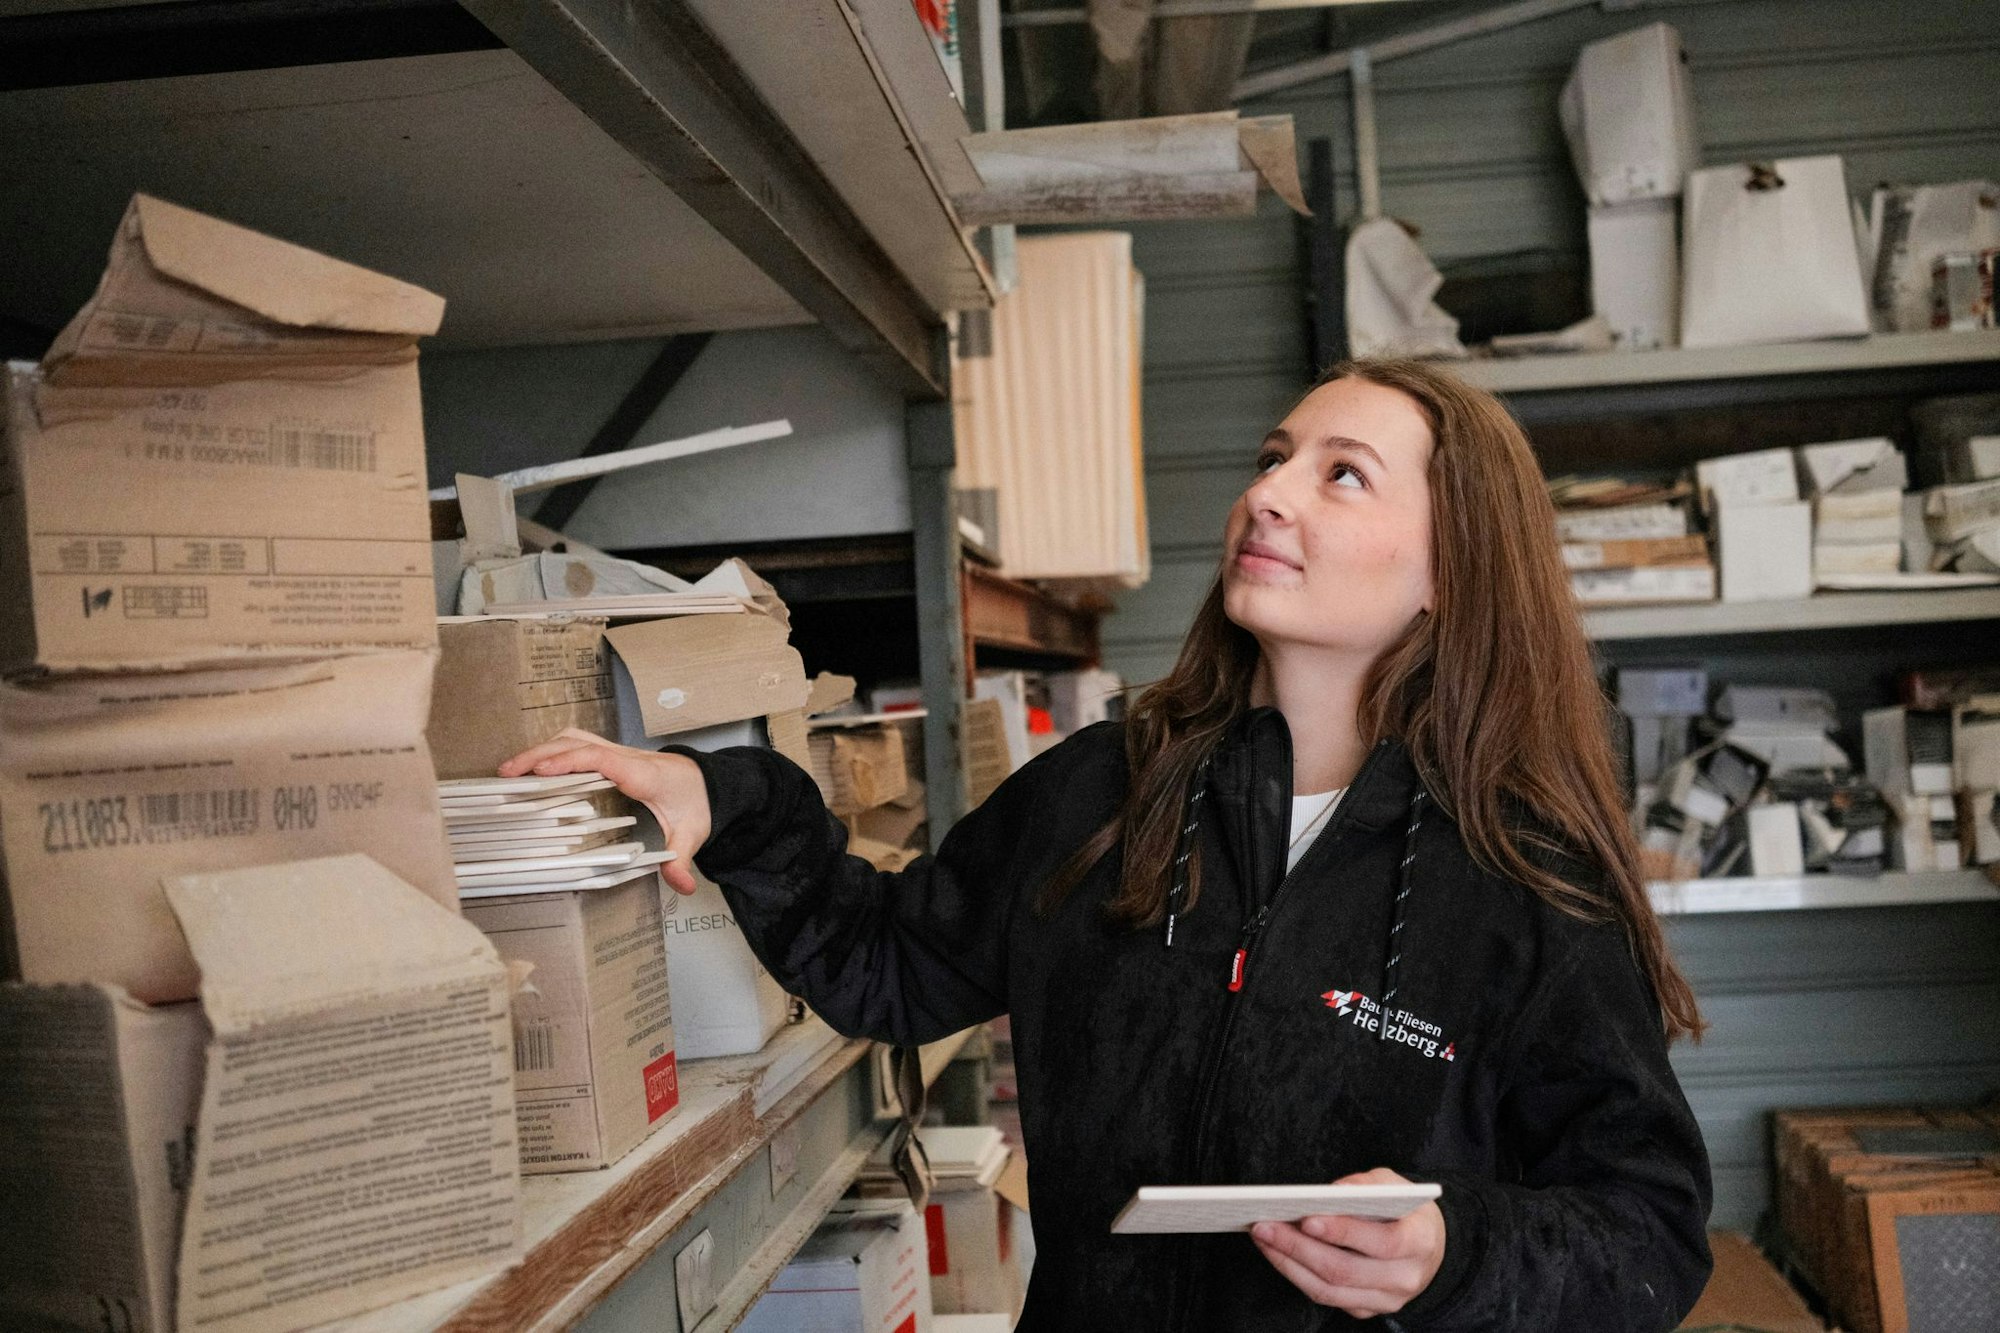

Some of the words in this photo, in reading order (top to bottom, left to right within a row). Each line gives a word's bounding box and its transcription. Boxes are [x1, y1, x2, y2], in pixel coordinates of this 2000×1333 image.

[664, 914, 736, 935] FLIESEN
[1352, 1009, 1439, 1058] Hezberg
[1395, 1009, 1442, 1038] Fliesen
[550, 1152, 584, 1163] KARTON
